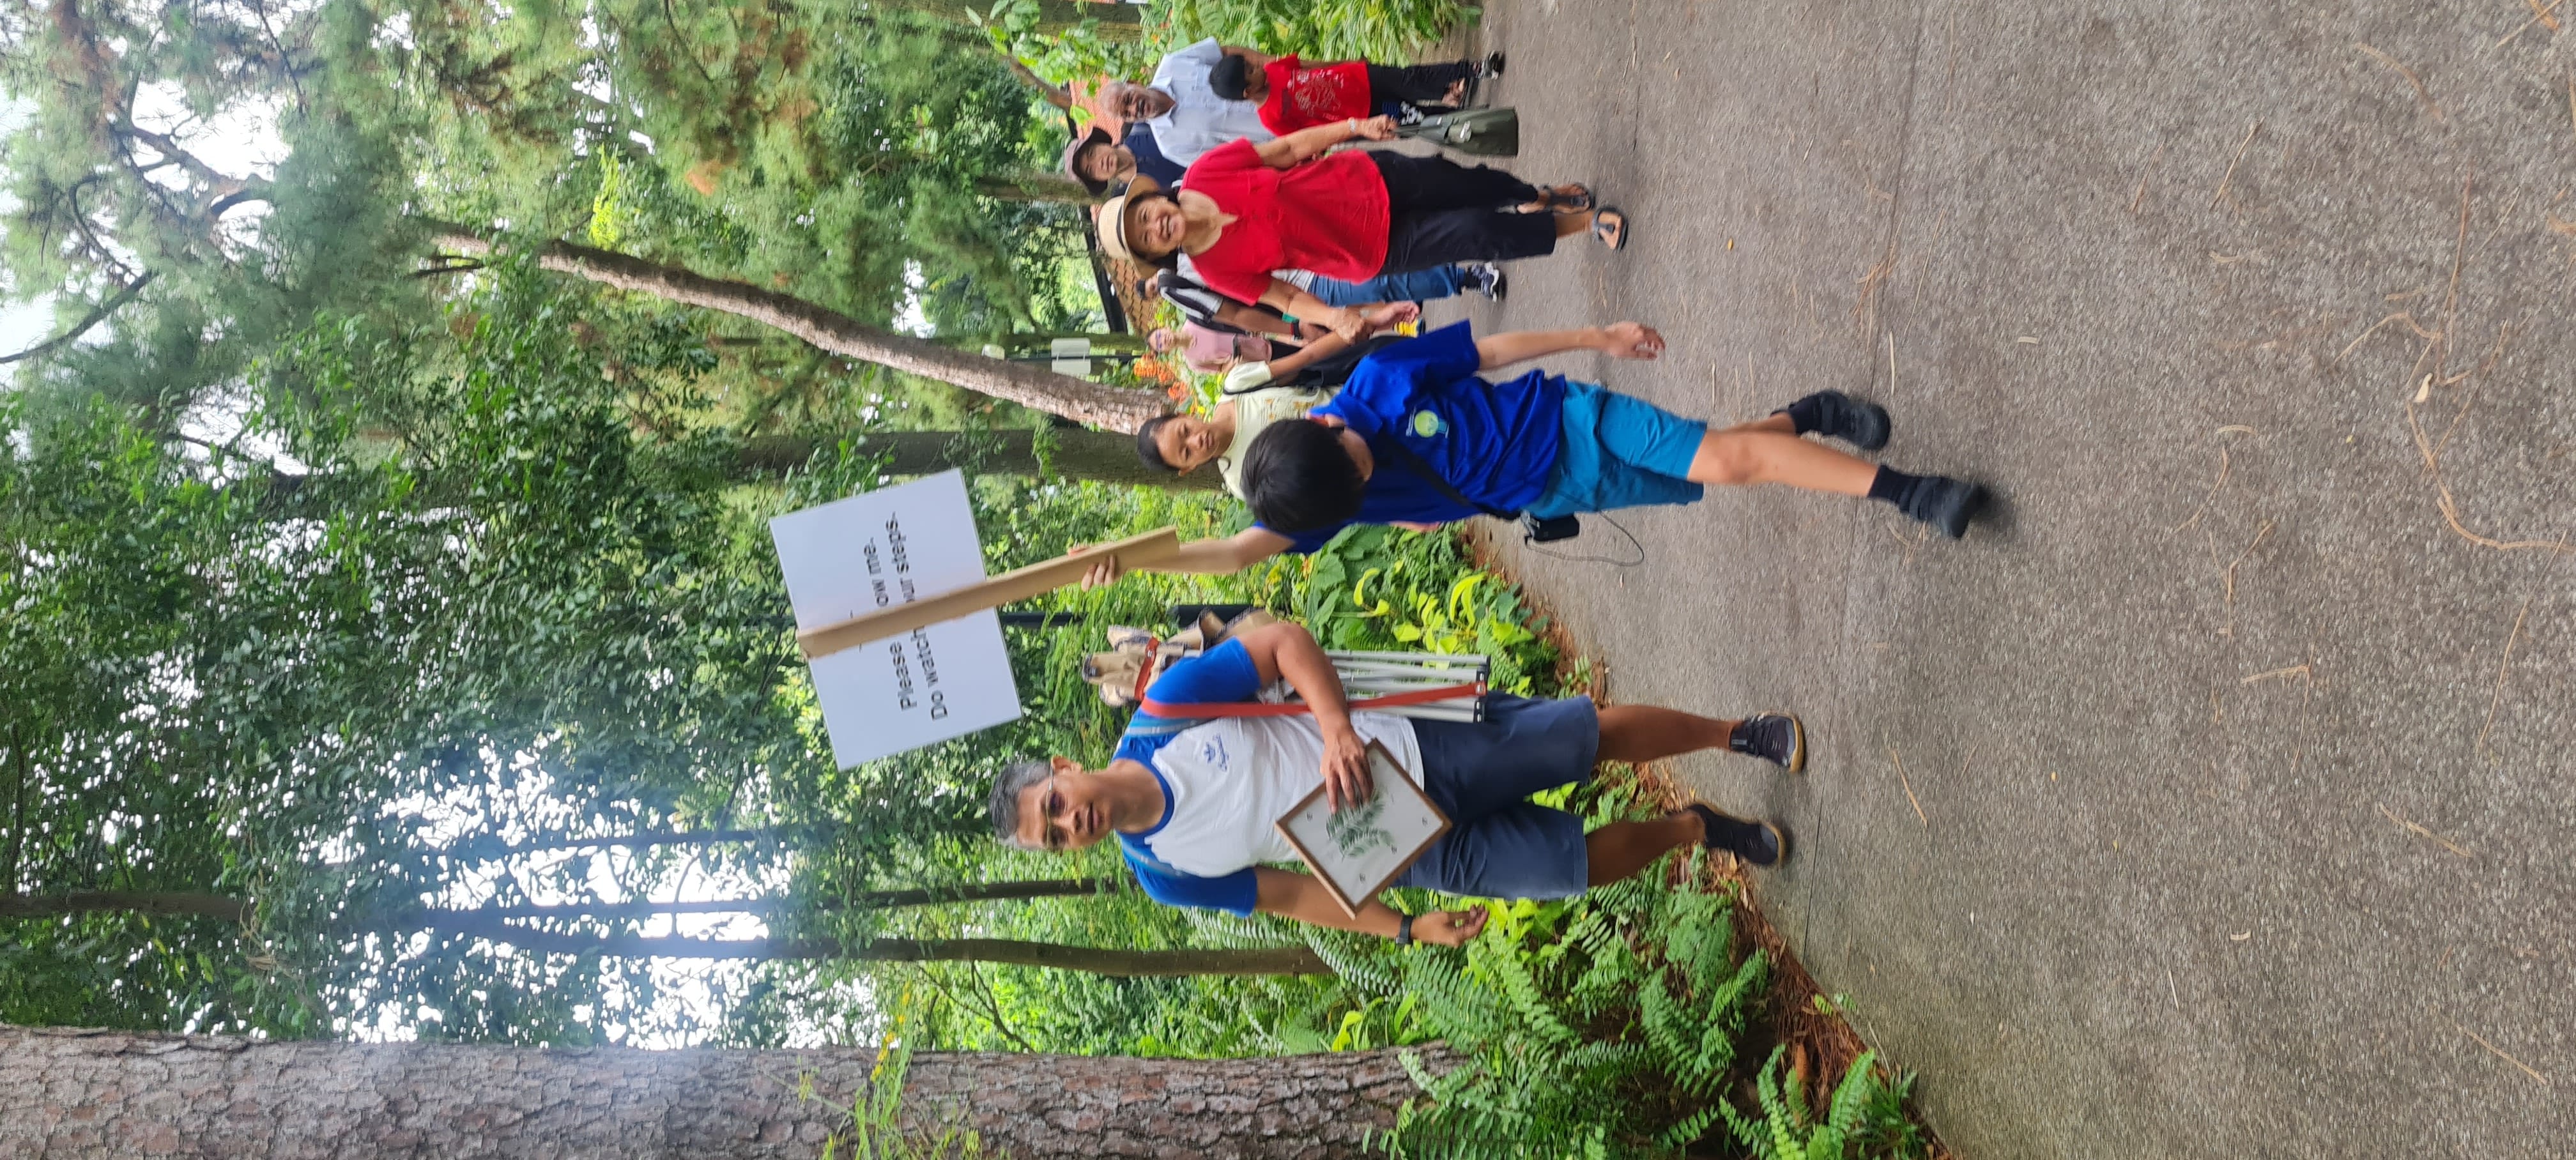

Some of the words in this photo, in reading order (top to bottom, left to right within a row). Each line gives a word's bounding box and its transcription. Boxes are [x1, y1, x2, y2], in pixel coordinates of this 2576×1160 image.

[864, 537, 882, 576] me.
[885, 511, 910, 574] steps.
[890, 641, 917, 712] Please
[910, 625, 939, 689] watch
[931, 690, 948, 721] Do
